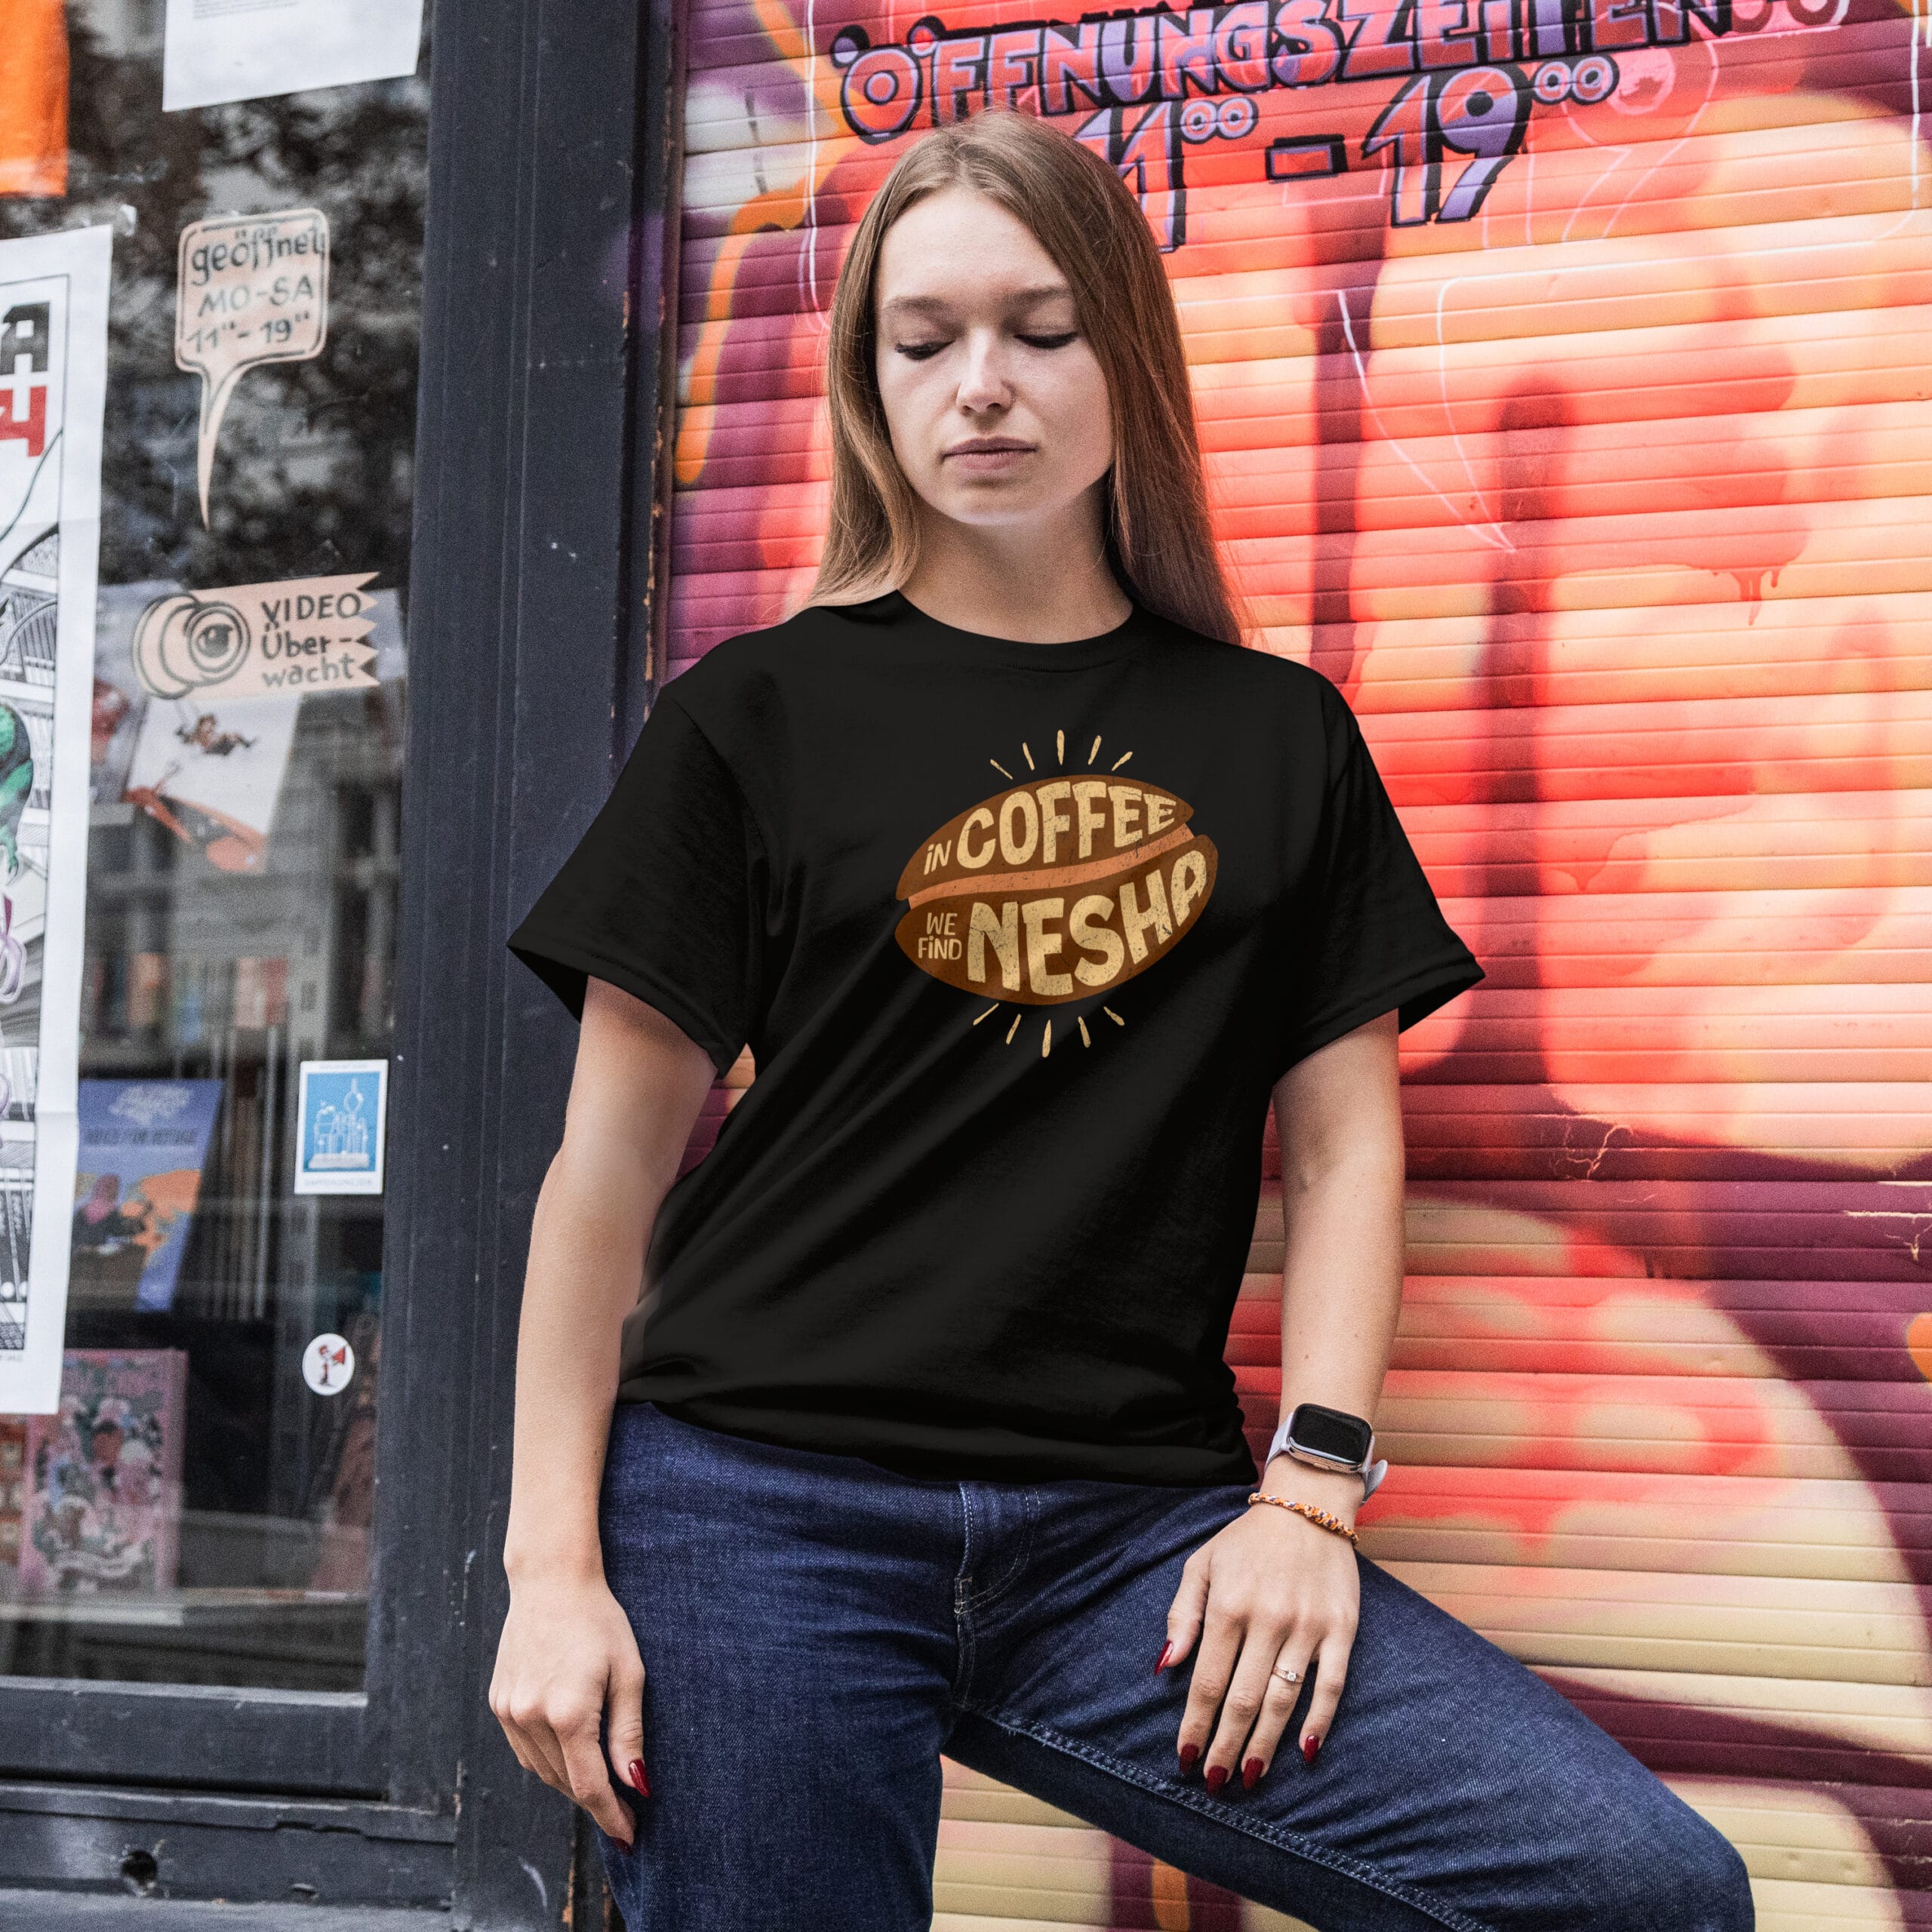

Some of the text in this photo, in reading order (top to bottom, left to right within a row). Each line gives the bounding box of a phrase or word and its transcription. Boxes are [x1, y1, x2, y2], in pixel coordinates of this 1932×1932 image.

[260, 592, 361, 623] VIDEO
[262, 653, 355, 687] wacht
[957, 780, 1177, 869] COFFEE
[926, 912, 957, 936] WE
[967, 850, 1207, 996] NESHA
